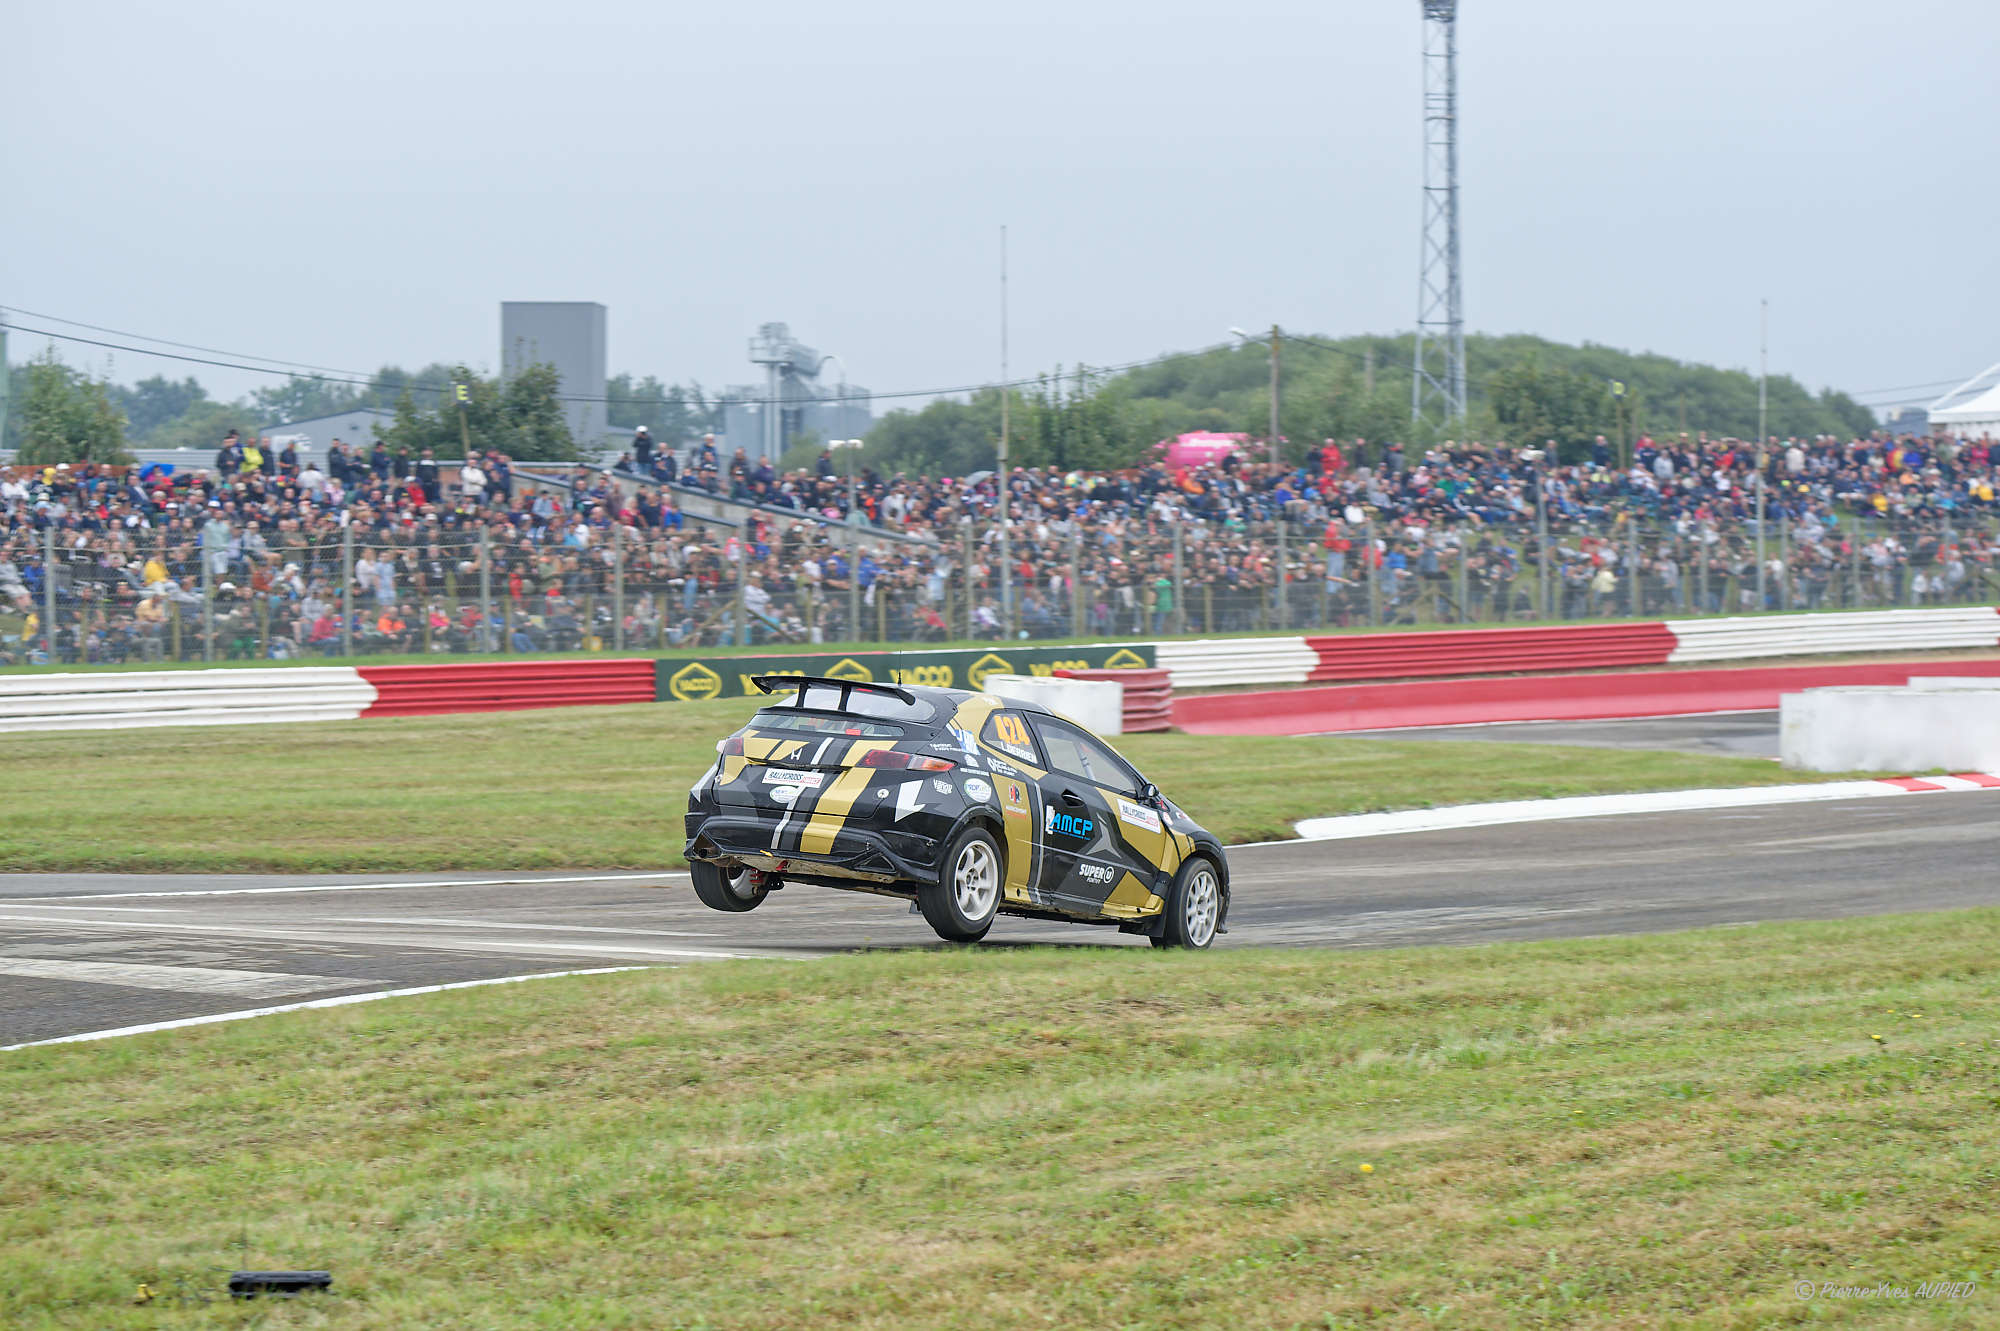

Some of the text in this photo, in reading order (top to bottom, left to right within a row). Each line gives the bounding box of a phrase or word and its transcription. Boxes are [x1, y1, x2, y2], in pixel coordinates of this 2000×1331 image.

[994, 715, 1030, 745] 424
[1049, 812, 1093, 836] AMCP
[1079, 864, 1105, 880] SUPER
